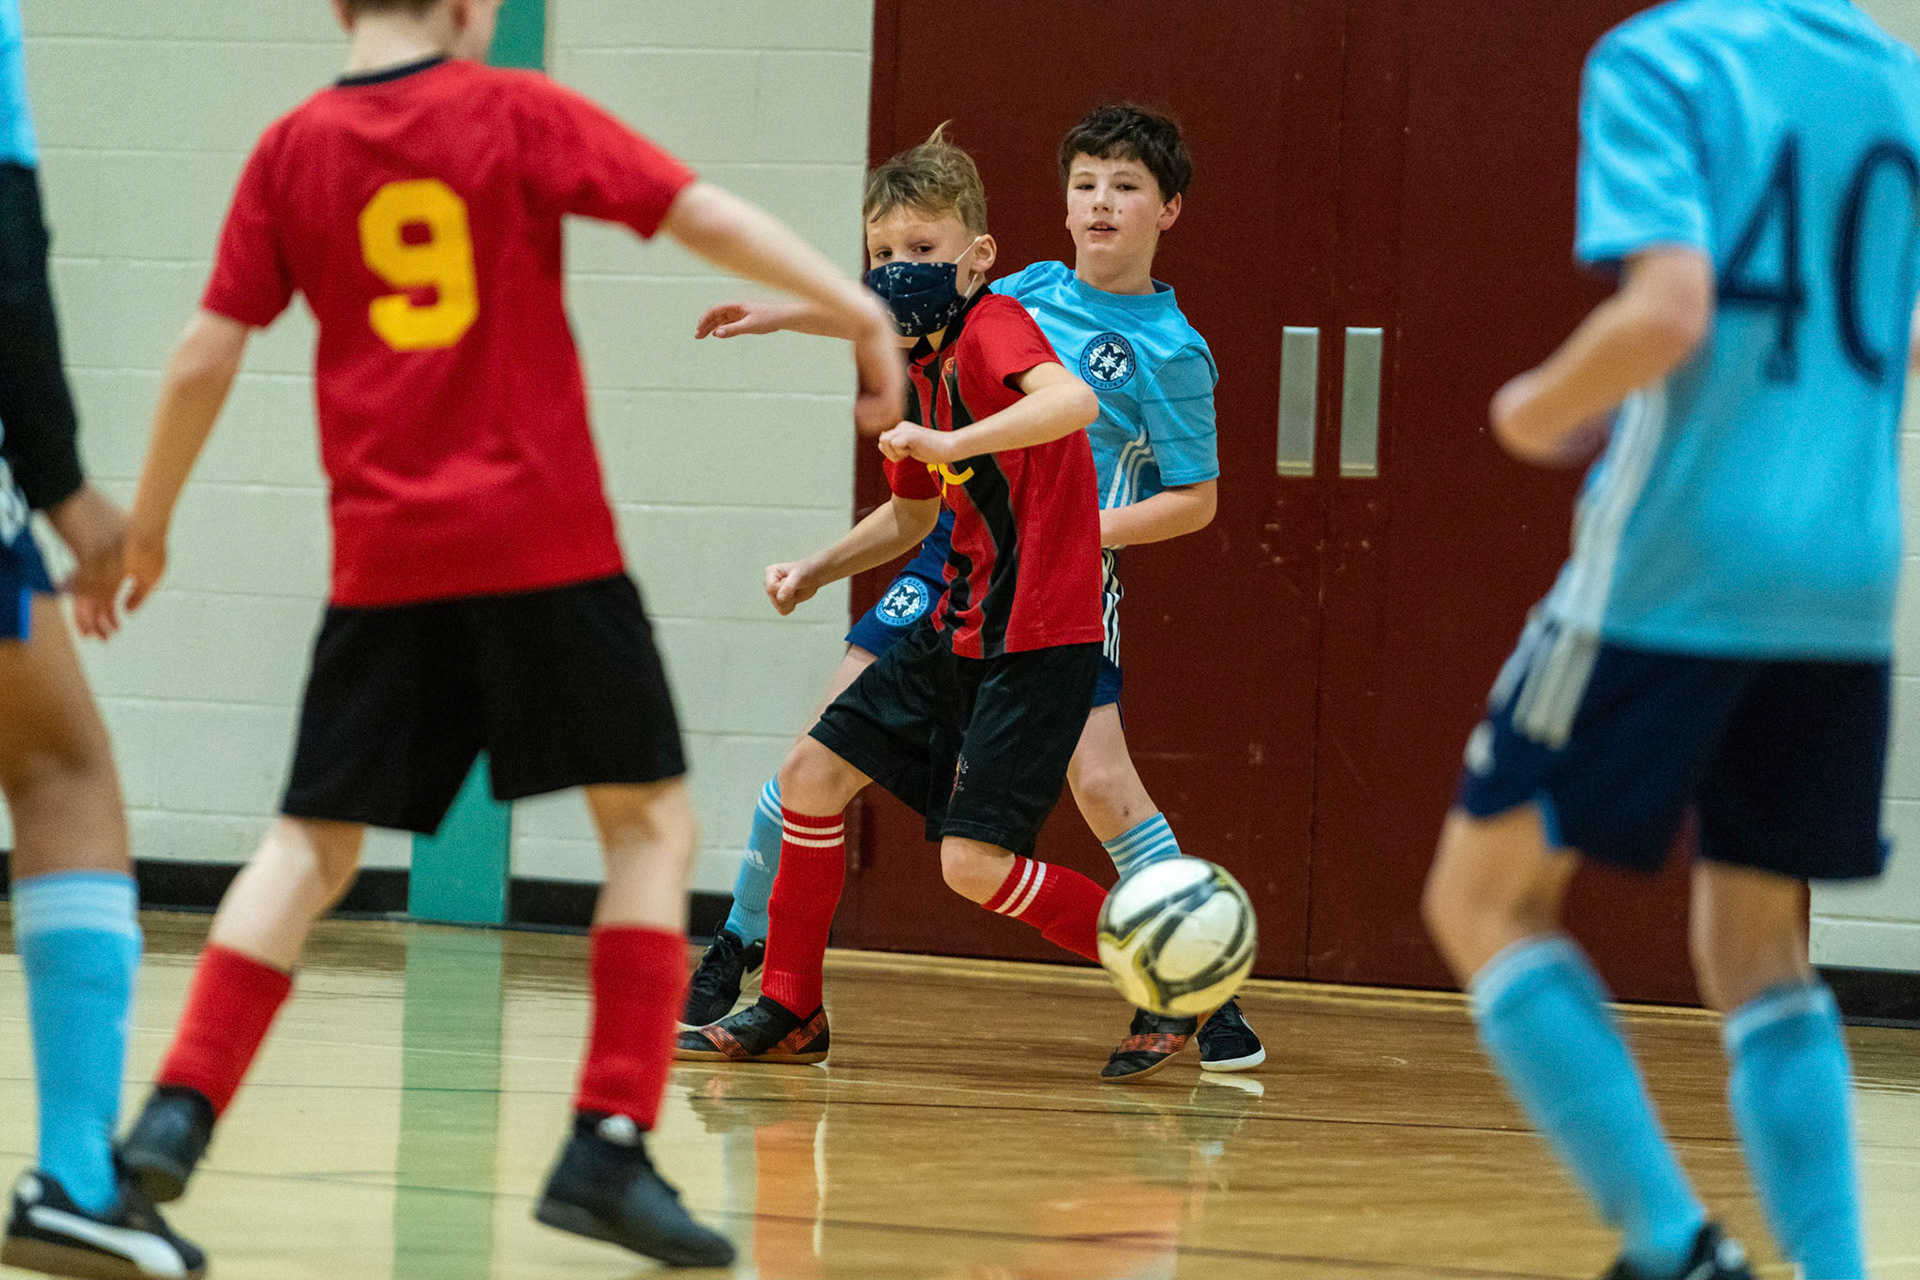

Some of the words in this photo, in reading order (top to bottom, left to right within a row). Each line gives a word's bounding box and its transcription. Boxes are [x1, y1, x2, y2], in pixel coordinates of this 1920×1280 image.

[358, 179, 480, 352] 9
[1716, 132, 1920, 386] 40
[1082, 362, 1097, 385] SOCCER
[1087, 336, 1109, 351] MOUNT
[1112, 336, 1134, 377] WASHINGTON
